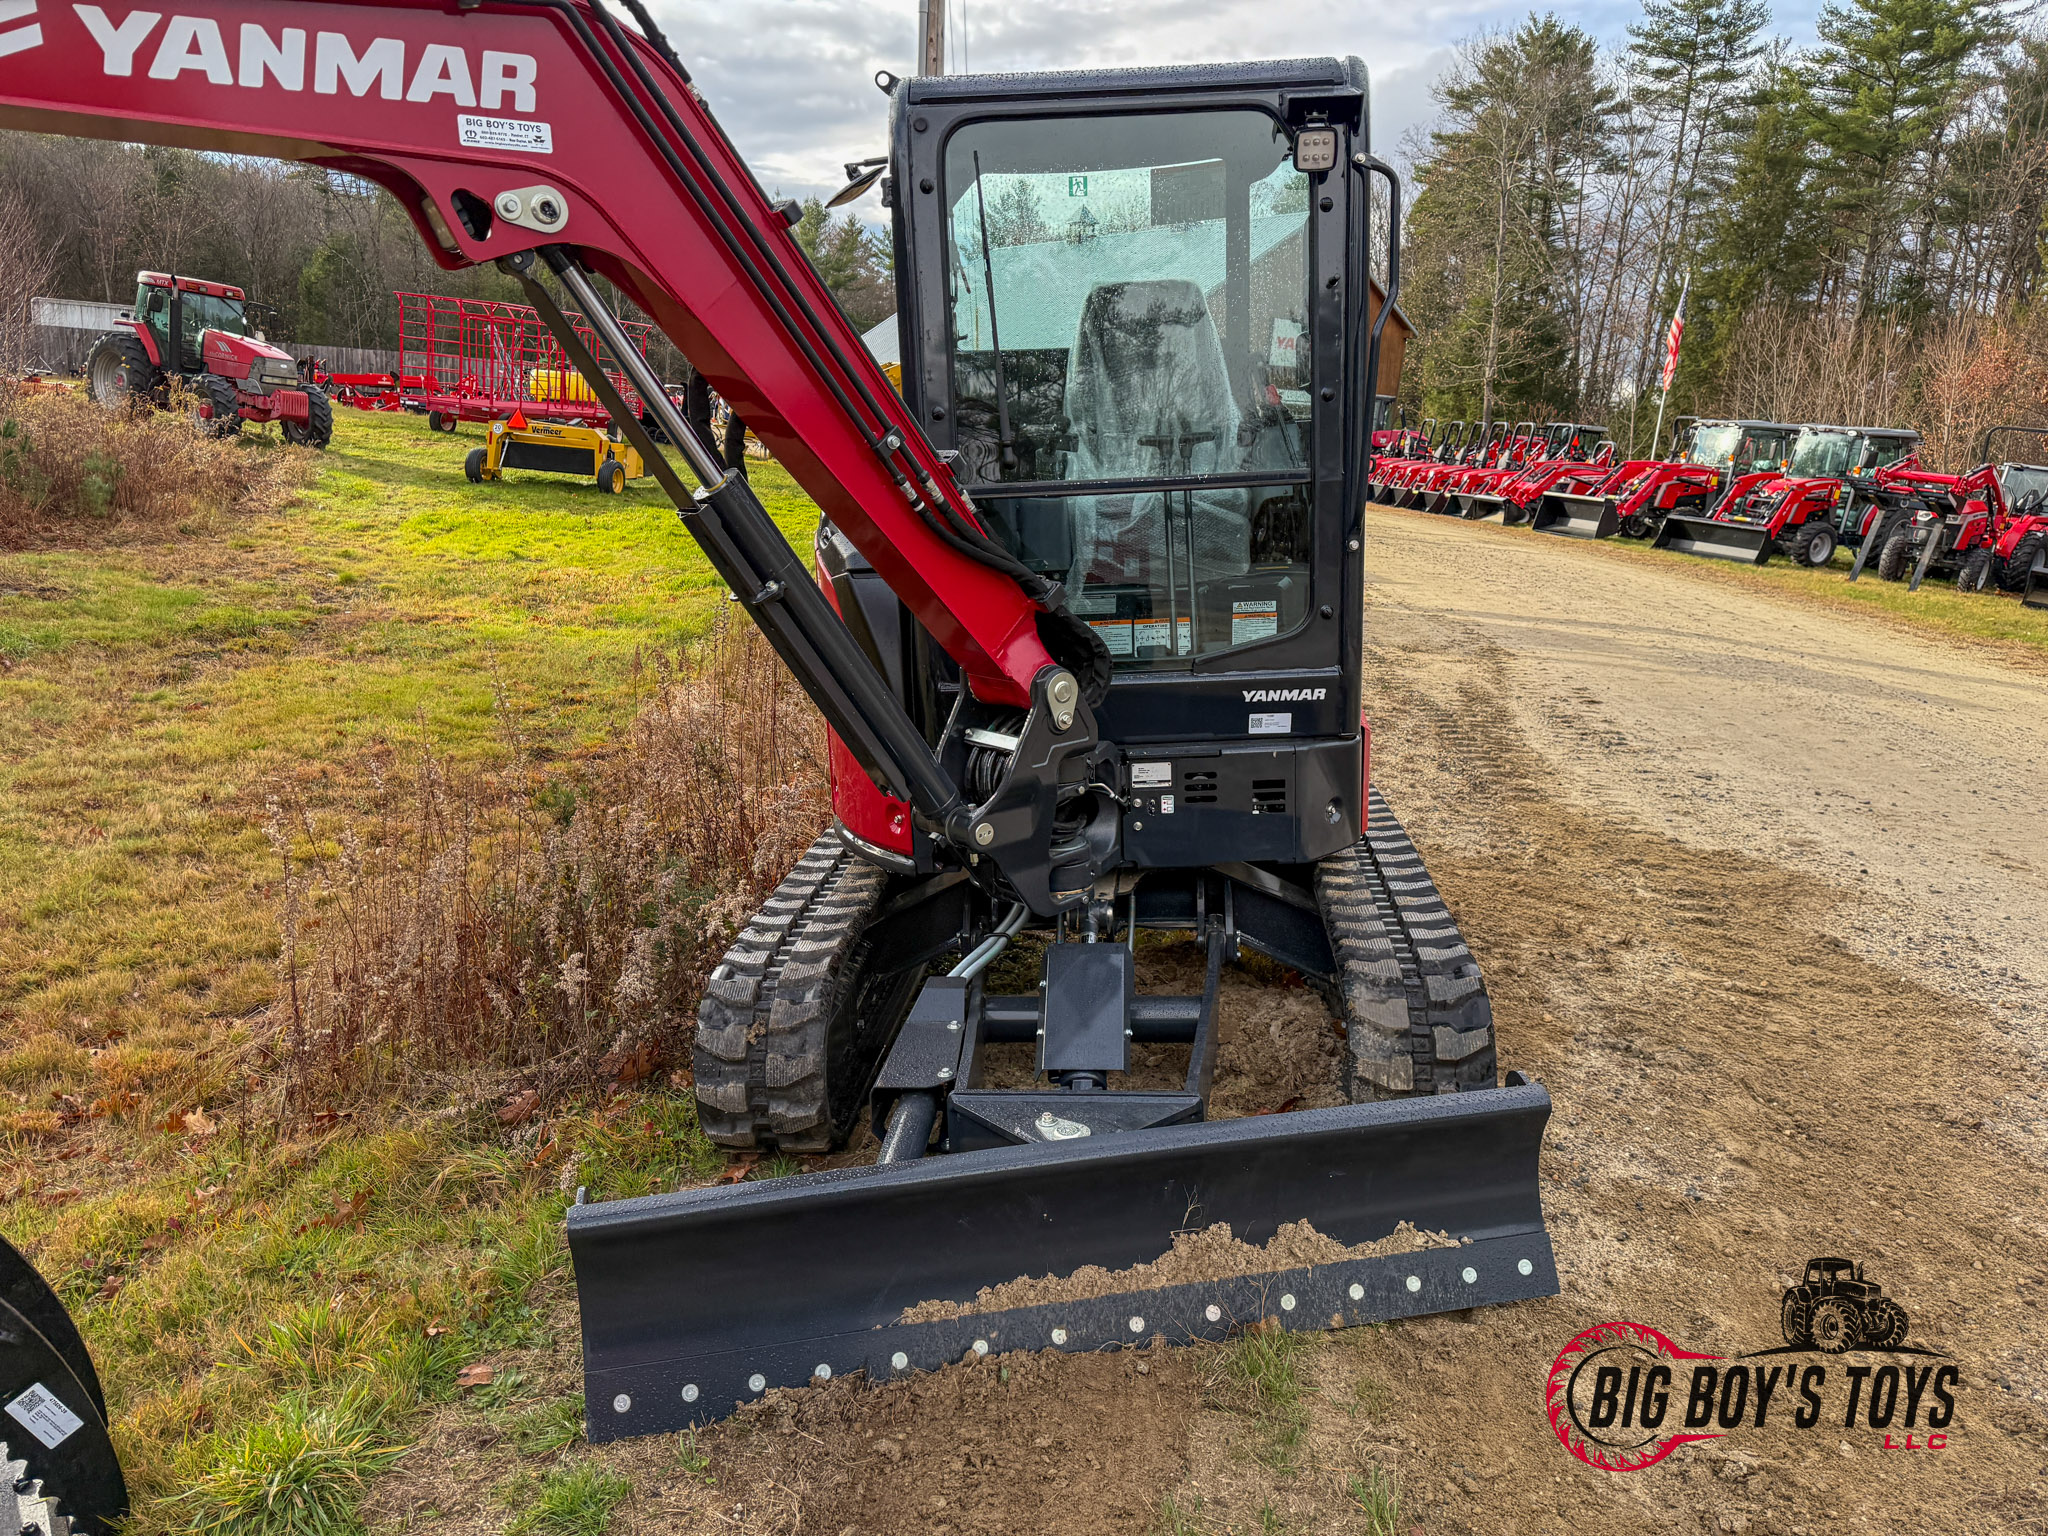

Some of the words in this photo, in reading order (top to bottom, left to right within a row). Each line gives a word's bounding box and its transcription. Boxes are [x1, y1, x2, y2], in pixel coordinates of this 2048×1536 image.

[72, 3, 538, 113] YANMAR
[466, 118, 483, 127] BIG
[486, 120, 515, 130] BOY'S
[517, 123, 542, 133] TOYS
[532, 426, 562, 435] Vermeer
[1242, 688, 1327, 702] YANMAR
